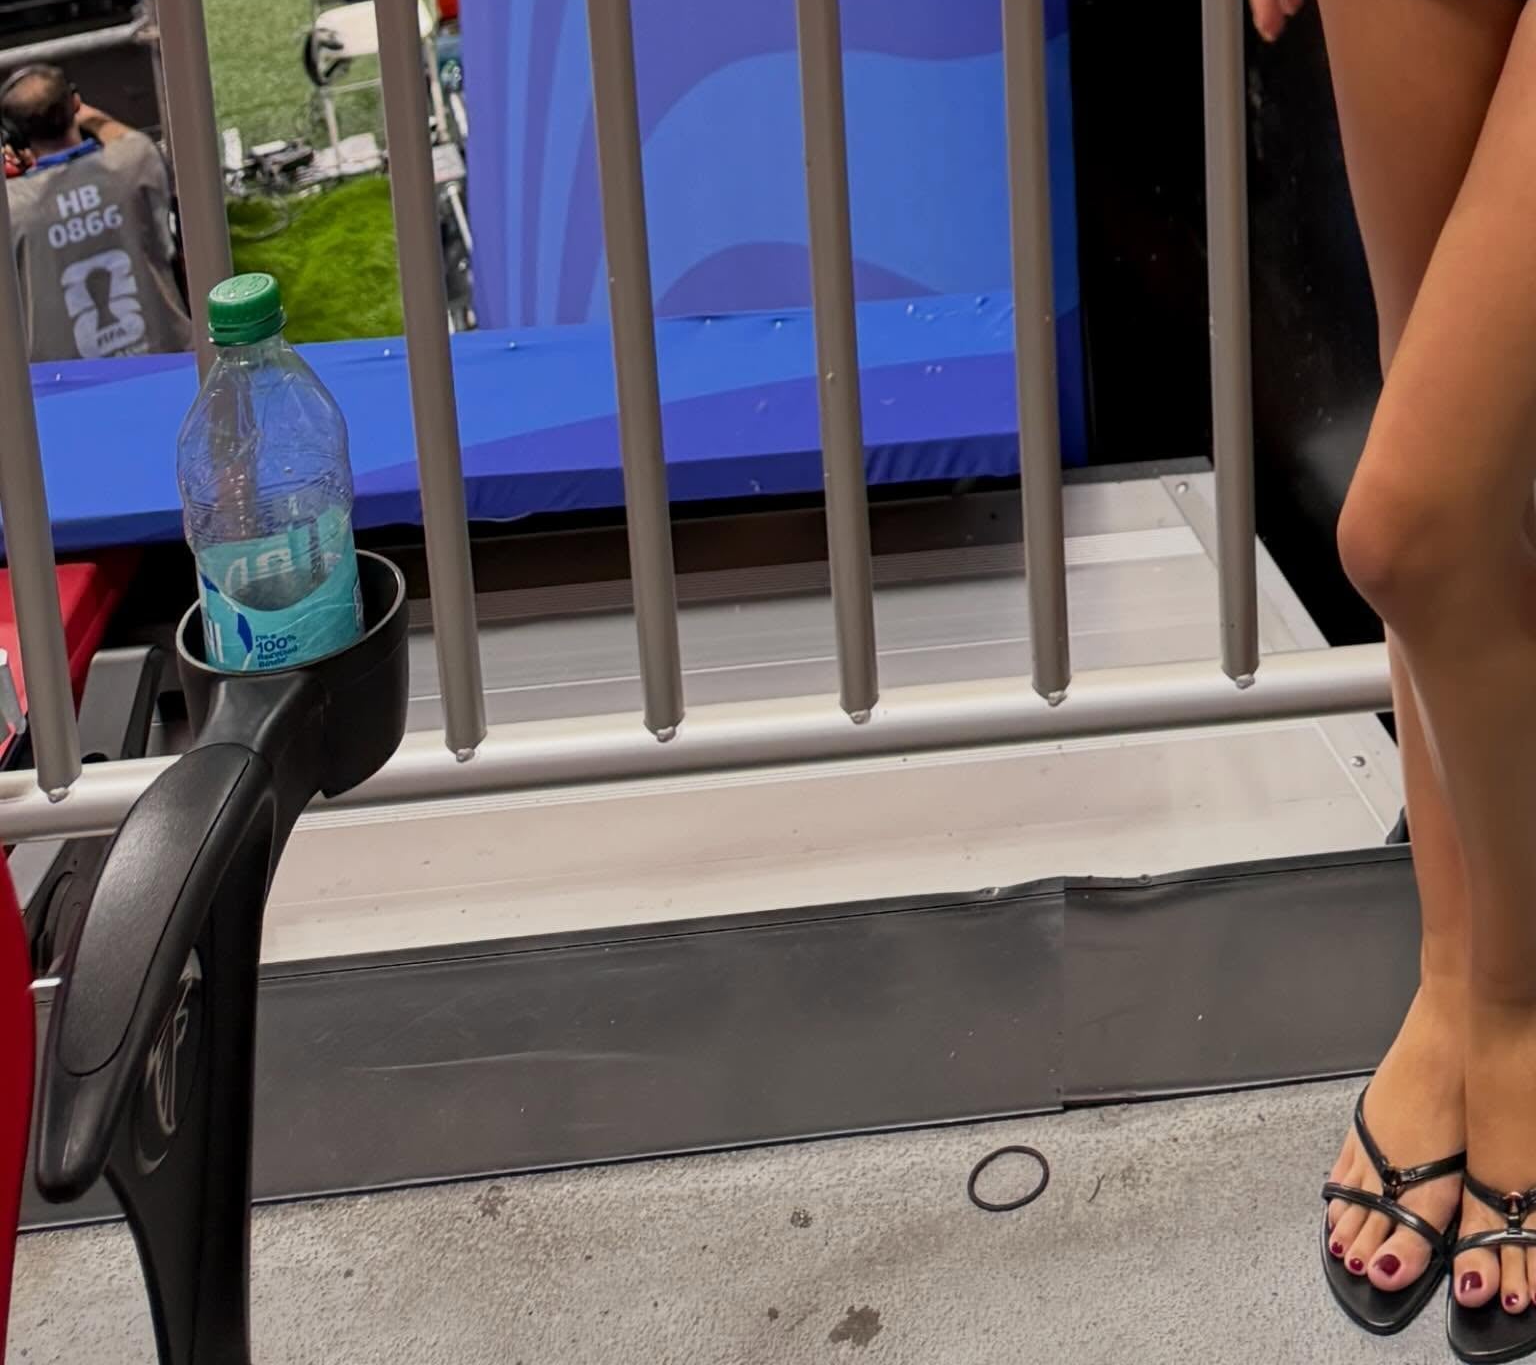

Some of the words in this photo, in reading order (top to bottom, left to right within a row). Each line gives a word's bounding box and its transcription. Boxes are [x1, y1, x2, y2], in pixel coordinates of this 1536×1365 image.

[56, 184, 101, 219] HB
[48, 204, 123, 249] 0866
[98, 326, 127, 347] FIFA
[256, 634, 297, 654] 100%
